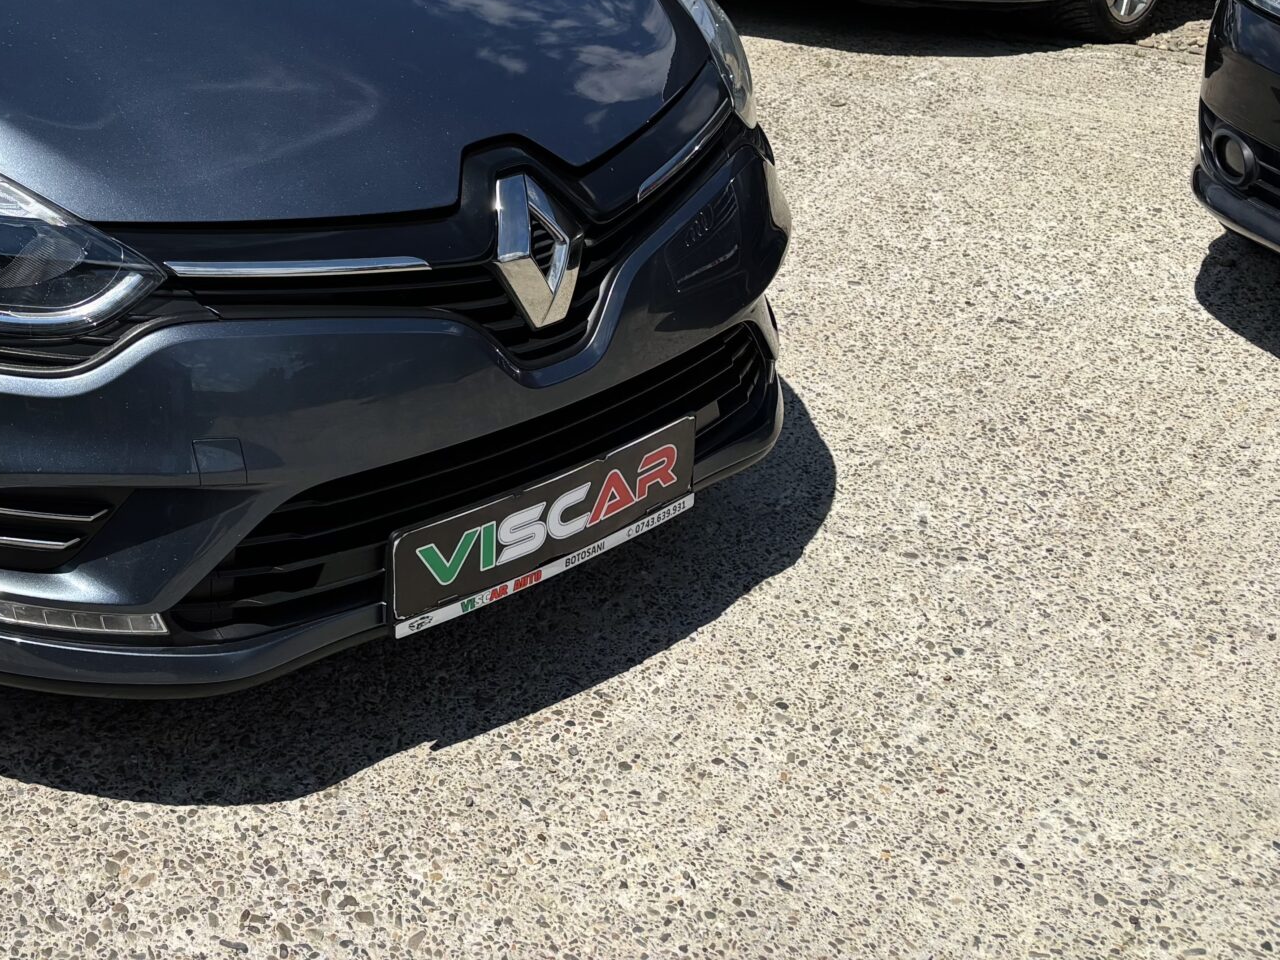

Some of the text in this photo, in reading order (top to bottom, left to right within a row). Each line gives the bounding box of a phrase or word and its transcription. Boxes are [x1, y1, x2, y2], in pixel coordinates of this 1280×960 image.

[415, 443, 679, 586] VISCAR
[513, 569, 543, 592] AUTO
[564, 541, 606, 568] BOTOSANI
[634, 501, 687, 534] 0743.639.931
